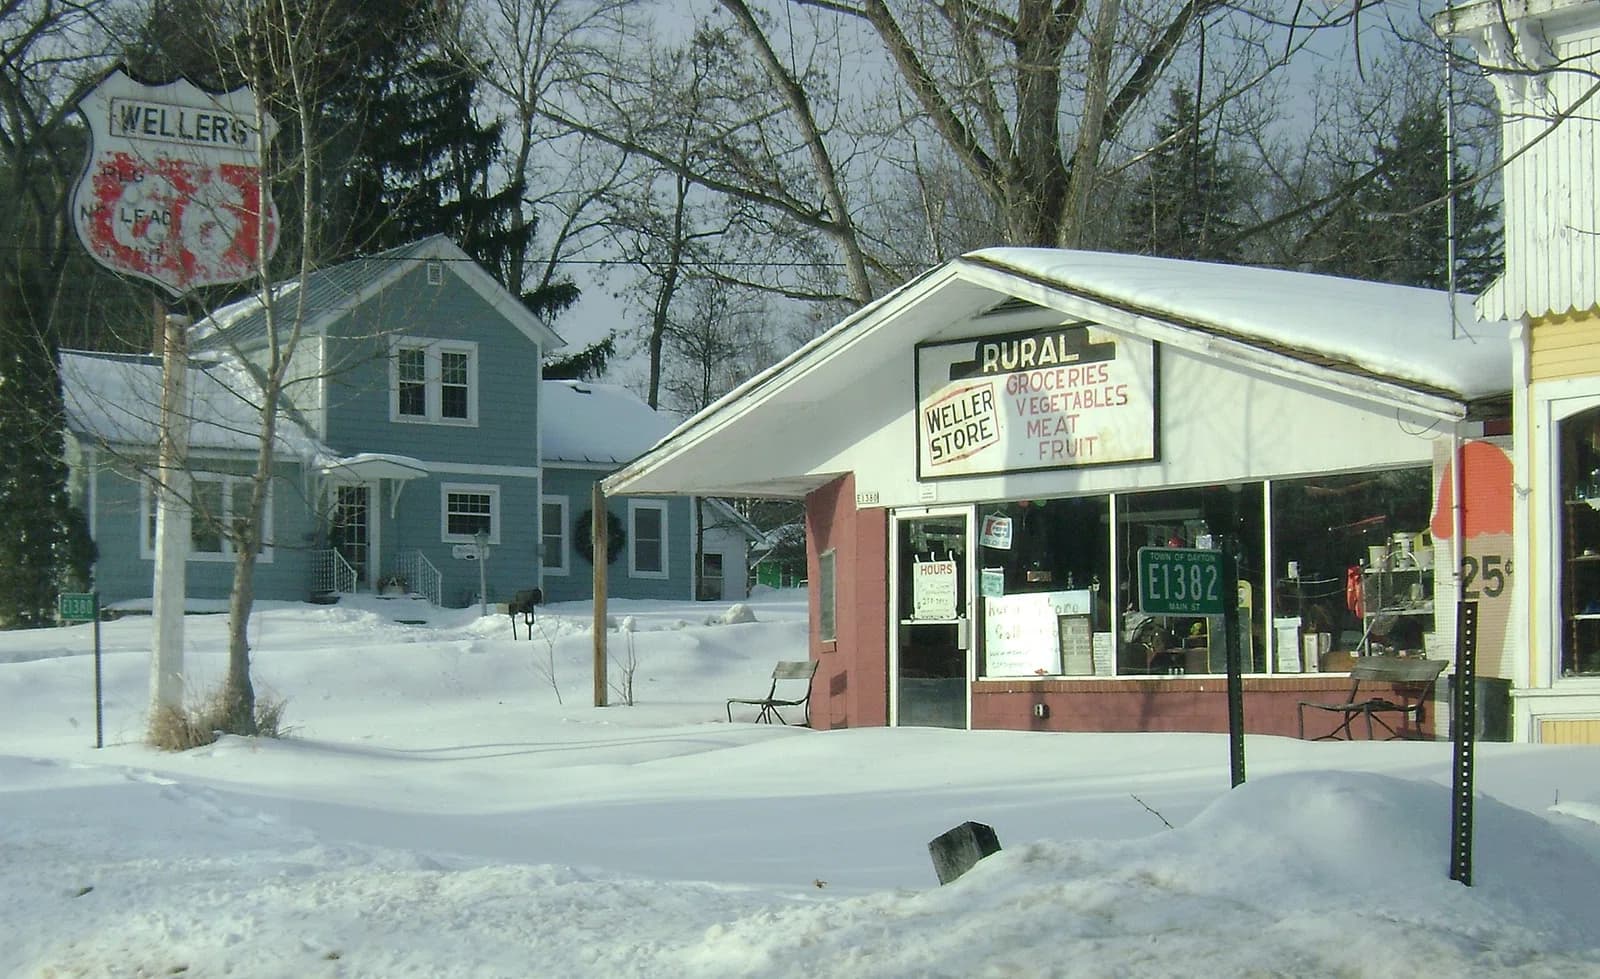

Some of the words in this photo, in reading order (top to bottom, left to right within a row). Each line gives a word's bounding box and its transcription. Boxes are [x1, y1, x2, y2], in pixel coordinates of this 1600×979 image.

[983, 334, 1080, 373] RURAL
[1006, 364, 1108, 395] GROCERIES
[926, 390, 993, 434] WELLER
[1016, 384, 1128, 416] VEGETABLES
[931, 417, 993, 460] STORE
[1027, 414, 1080, 439] MEAT
[1039, 436, 1098, 461] FRUIT
[920, 564, 953, 576] HOURS
[1150, 552, 1171, 561] TOWN
[1174, 553, 1185, 561] OF
[1187, 554, 1216, 562] DAYTON
[1149, 563, 1218, 600] E1382
[1169, 602, 1188, 610] MAIN
[1191, 603, 1201, 611] ST
